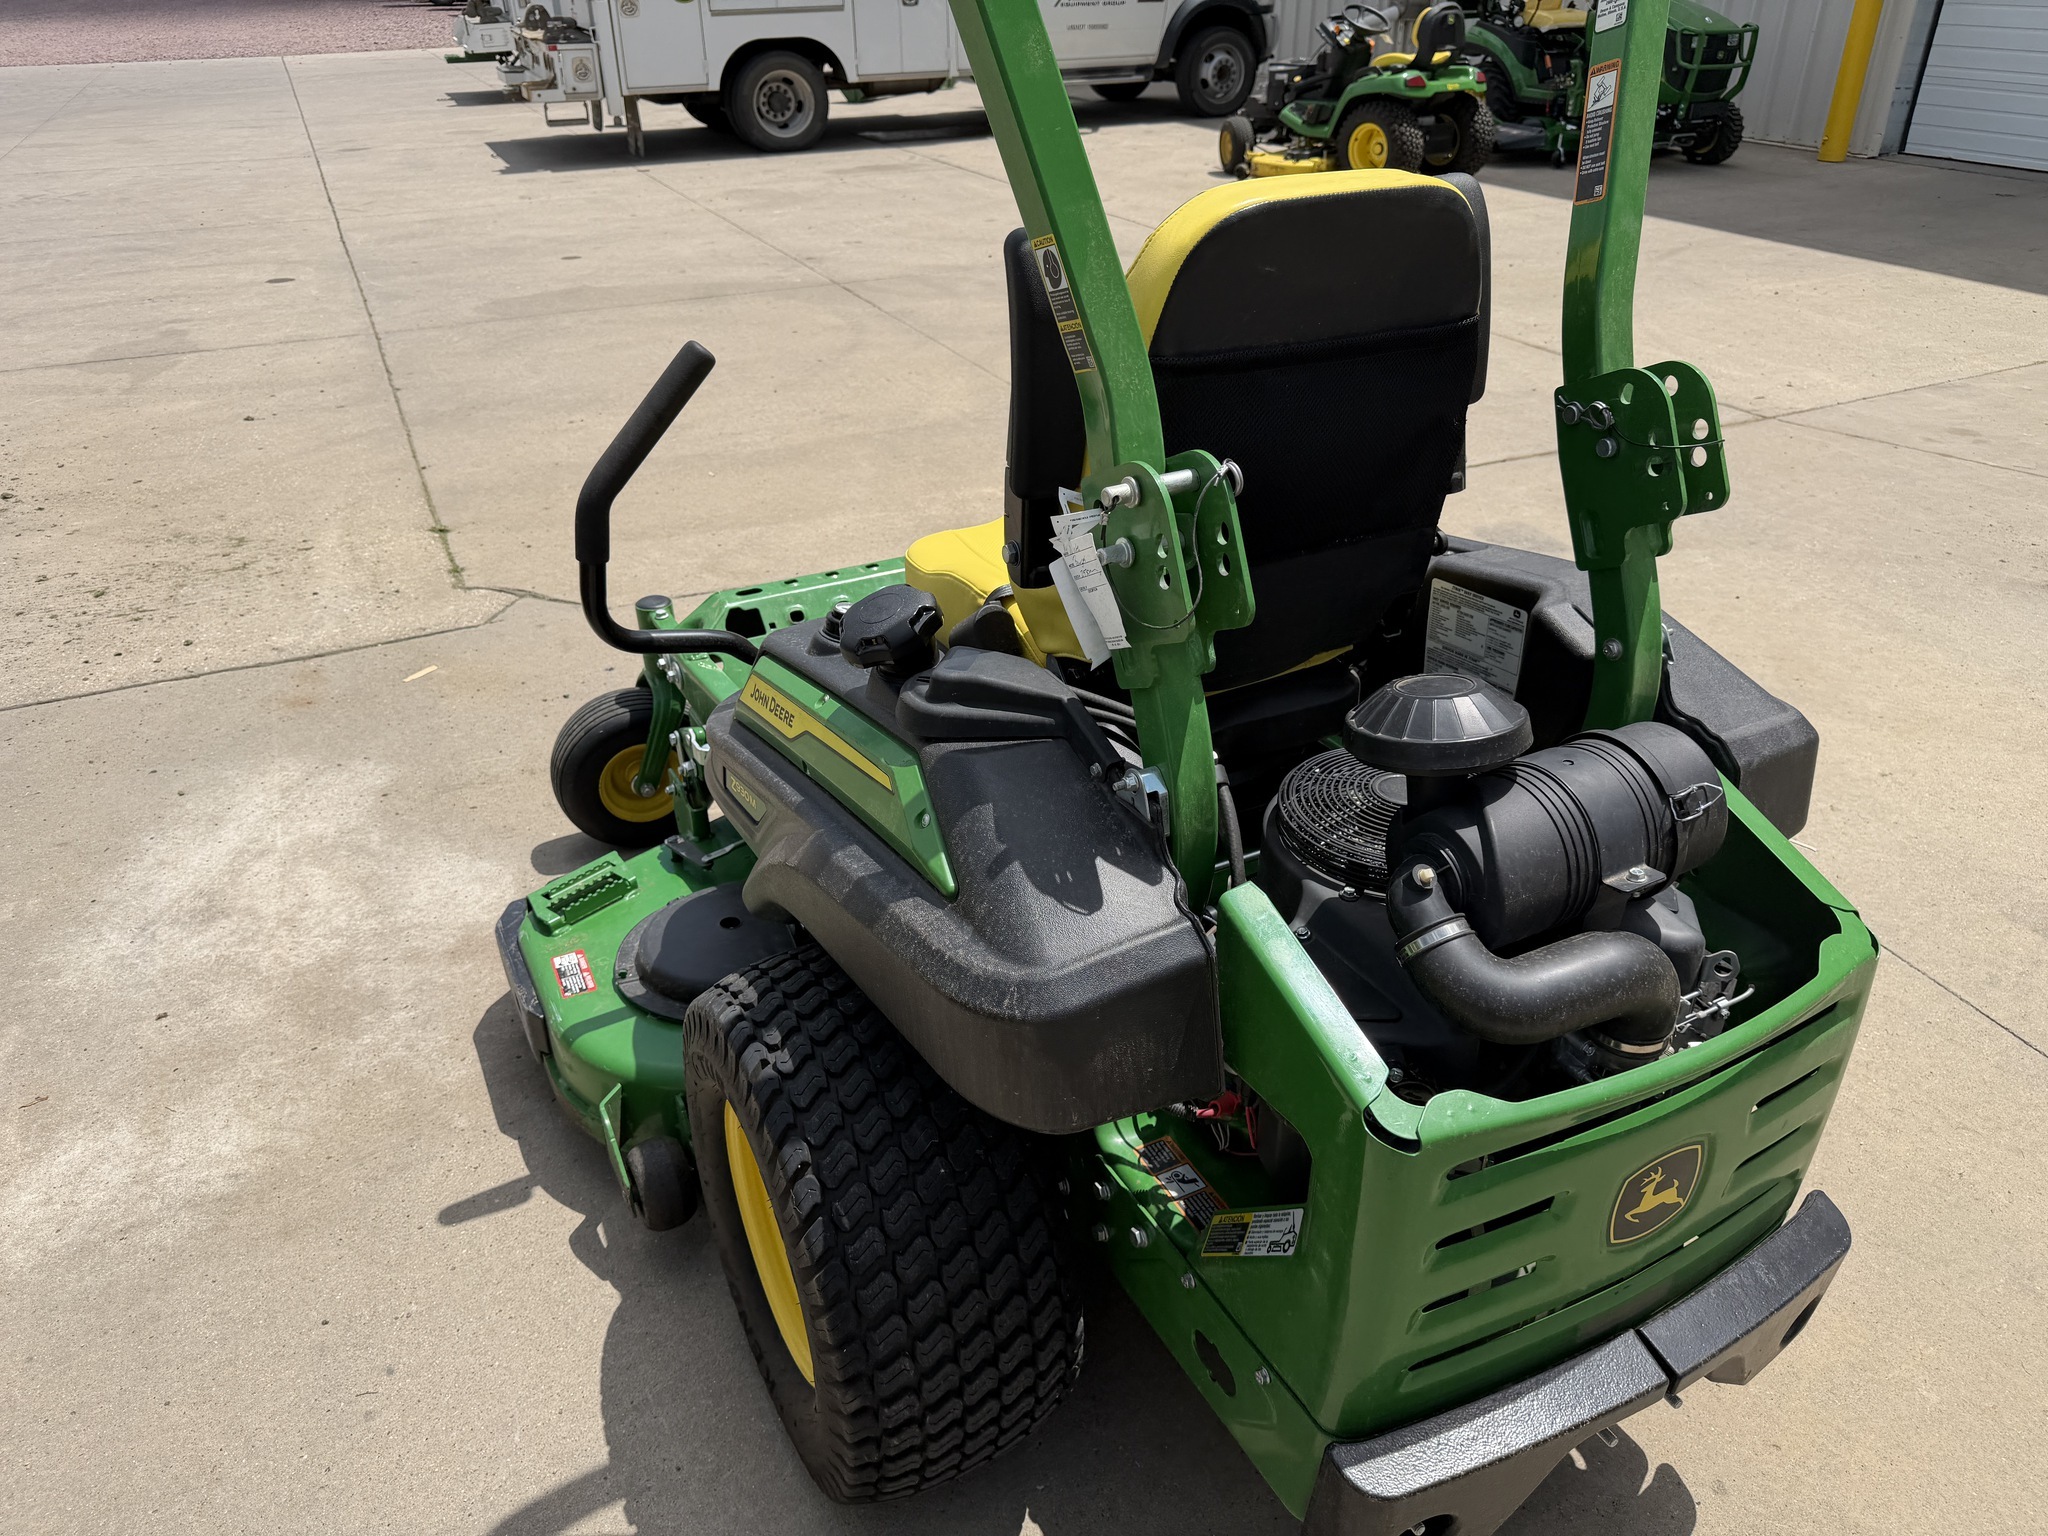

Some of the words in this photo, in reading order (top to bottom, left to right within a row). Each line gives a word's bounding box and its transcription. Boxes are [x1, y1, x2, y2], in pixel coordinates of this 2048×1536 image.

[750, 683, 770, 709] JOHN
[769, 696, 795, 728] DEERE
[730, 776, 757, 810] Z930M
